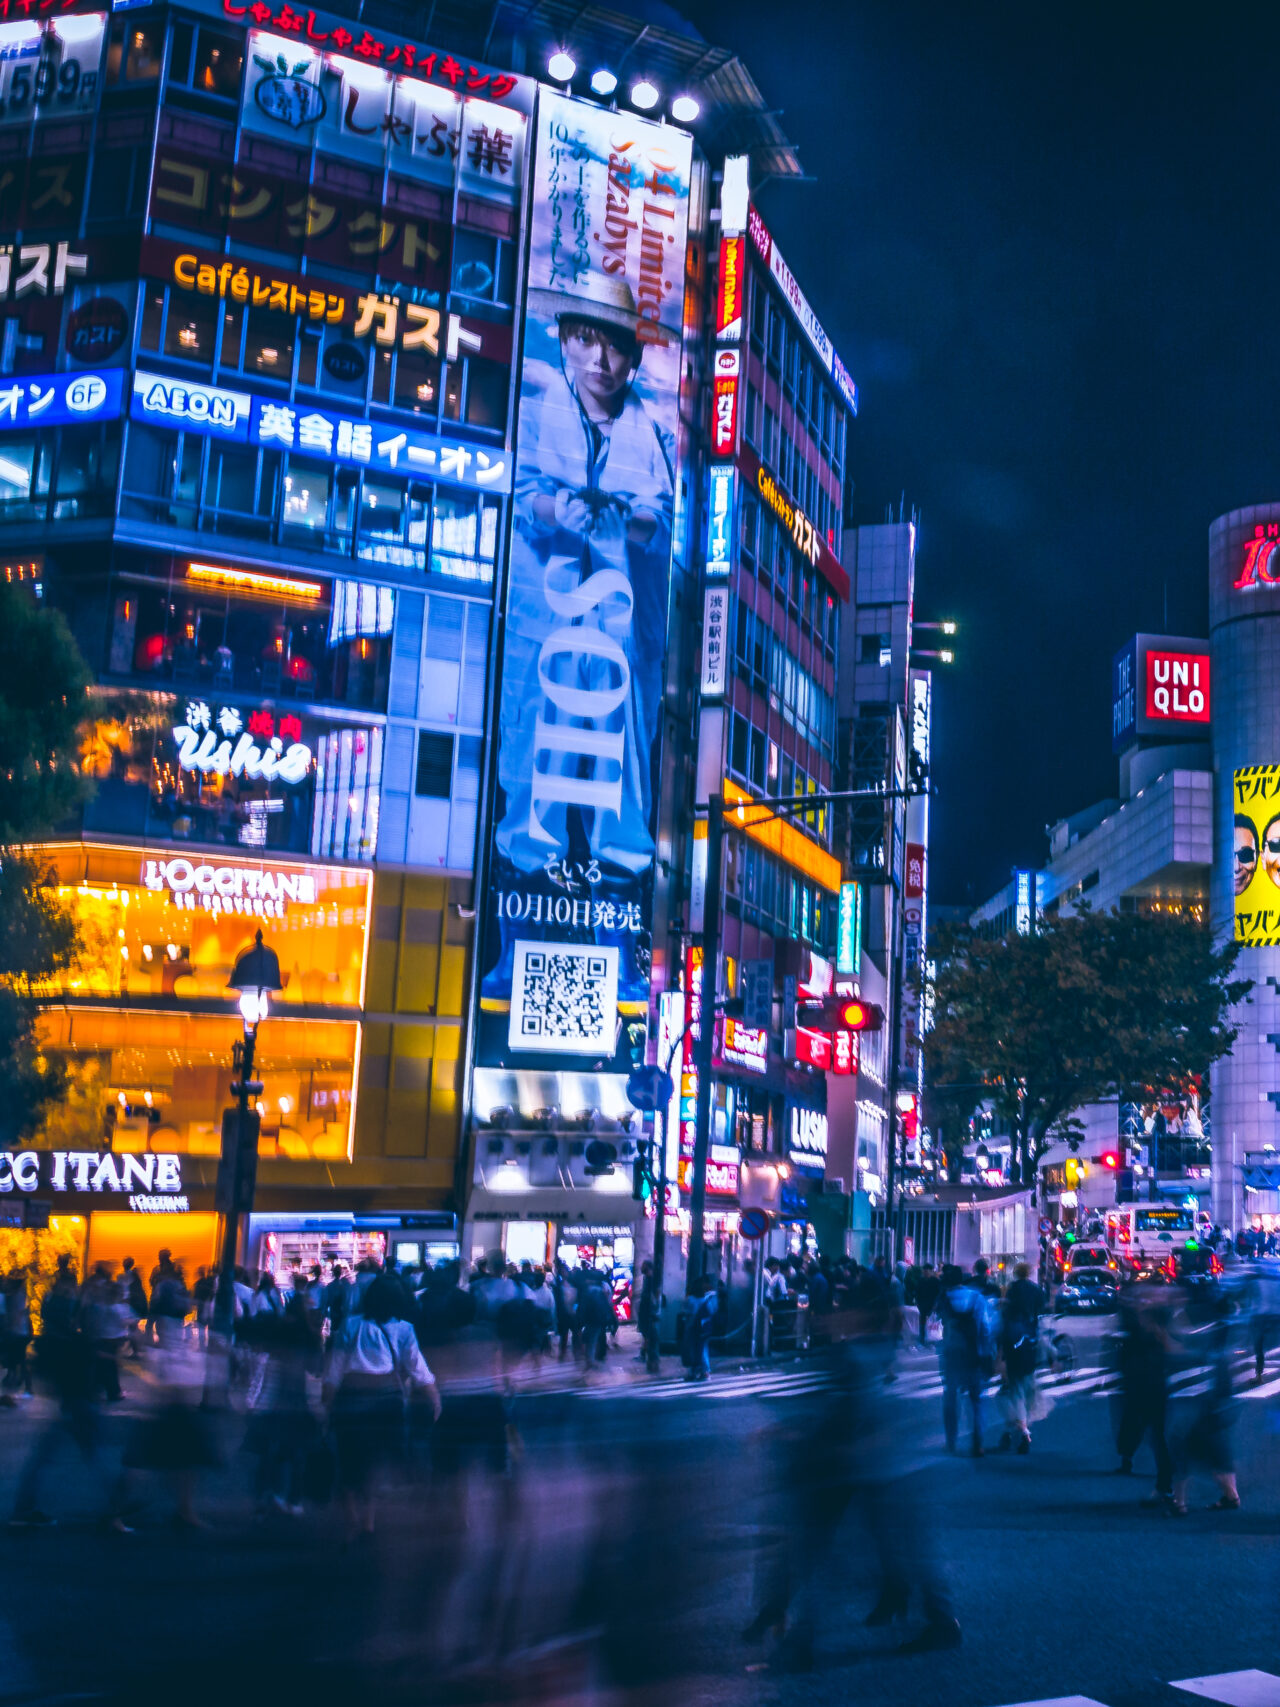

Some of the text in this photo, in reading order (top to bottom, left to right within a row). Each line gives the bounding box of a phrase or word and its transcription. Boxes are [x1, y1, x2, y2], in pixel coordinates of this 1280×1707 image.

[222, 0, 518, 98] しゃぶしゃぶバイキング
[344, 85, 514, 174] しゃぶ葉
[156, 158, 440, 268] コンタクト
[636, 201, 675, 347] Limited
[354, 293, 482, 361] ガスト
[72, 384, 100, 407] 6F
[147, 383, 237, 428] AEON
[259, 404, 504, 483] 英会話イーオン
[793, 509, 820, 567] ガスト
[707, 595, 723, 684] 渋谷駅前ビル
[1118, 653, 1131, 696] THE
[1154, 659, 1200, 686] UNI
[187, 701, 301, 742] 渋谷 焼肉
[529, 554, 633, 846] SOIL
[1113, 687, 1135, 738] PRIME
[1154, 688, 1205, 714] QLO
[145, 858, 314, 904] L'OCCITANE
[908, 857, 921, 887] 免税
[496, 891, 641, 932] 10月10日発売
[791, 1107, 828, 1154] LUSH
